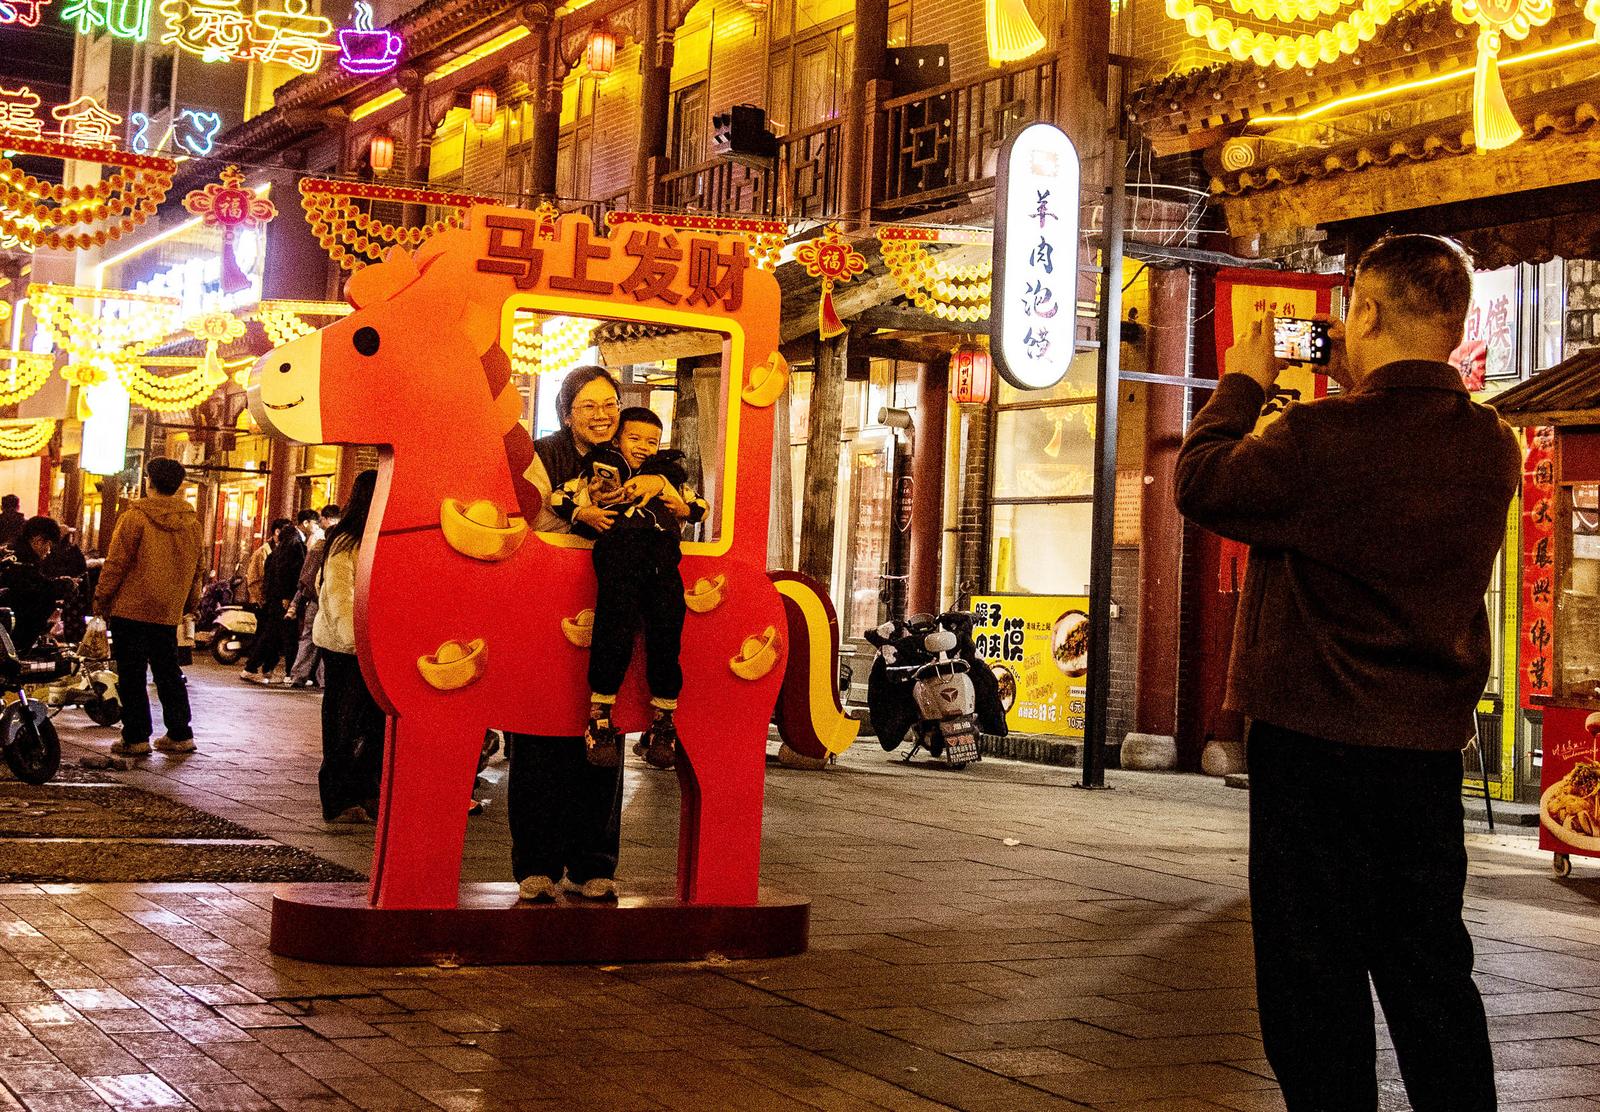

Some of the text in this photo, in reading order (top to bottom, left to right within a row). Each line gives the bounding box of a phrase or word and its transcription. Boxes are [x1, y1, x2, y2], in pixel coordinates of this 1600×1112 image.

[221, 199, 242, 218] 福
[477, 214, 750, 312] 马上发财
[822, 249, 841, 270] 福
[1021, 189, 1059, 363] 羊肉泡馍
